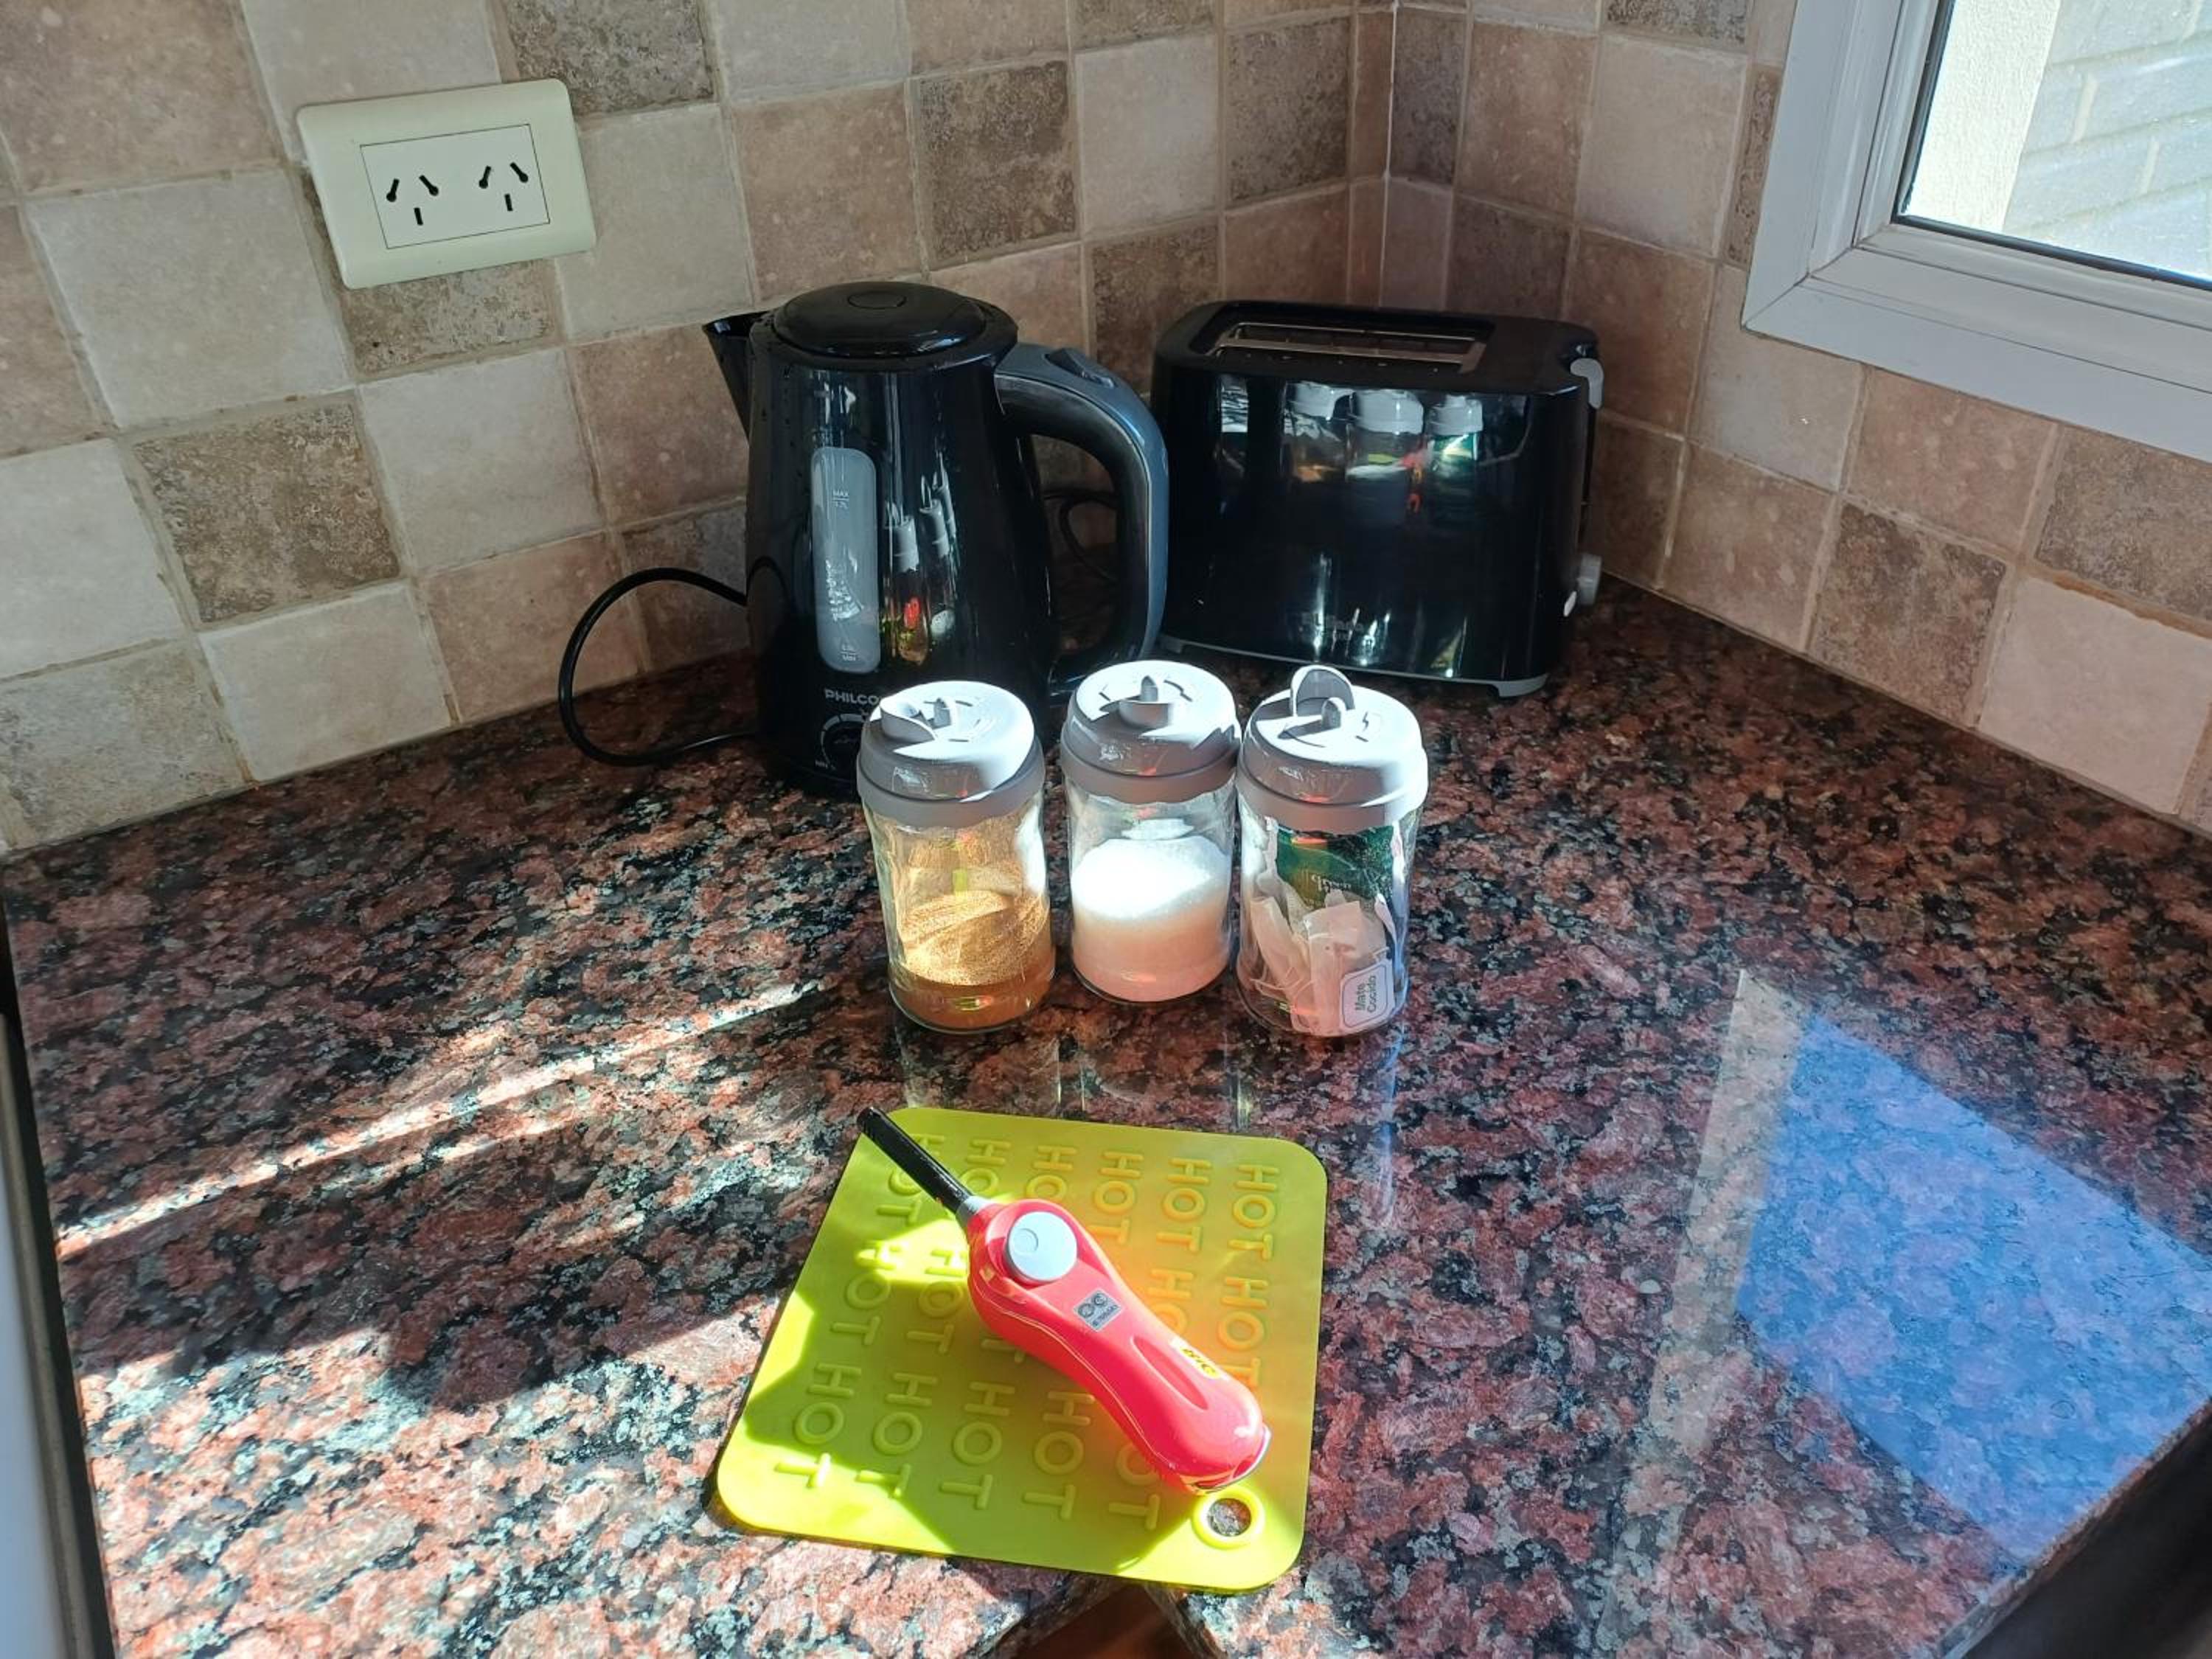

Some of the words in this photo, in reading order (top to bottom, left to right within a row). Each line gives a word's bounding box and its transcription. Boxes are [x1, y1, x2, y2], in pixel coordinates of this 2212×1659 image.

[824, 688, 880, 705] PHILCO
[1025, 1144, 1078, 1202] HO
[1088, 1150, 1144, 1245] HOT
[1155, 1156, 1214, 1253] HOT
[1228, 1163, 1281, 1260] HOT
[906, 1248, 969, 1355] HOT
[1146, 1267, 1194, 1333] HO
[1217, 1276, 1270, 1391] HOT
[774, 1362, 862, 1489] HOT
[855, 1371, 939, 1499] HOT
[939, 1380, 1016, 1511] HOT
[1022, 1391, 1096, 1520] HOT
[1107, 1441, 1161, 1531] OT
